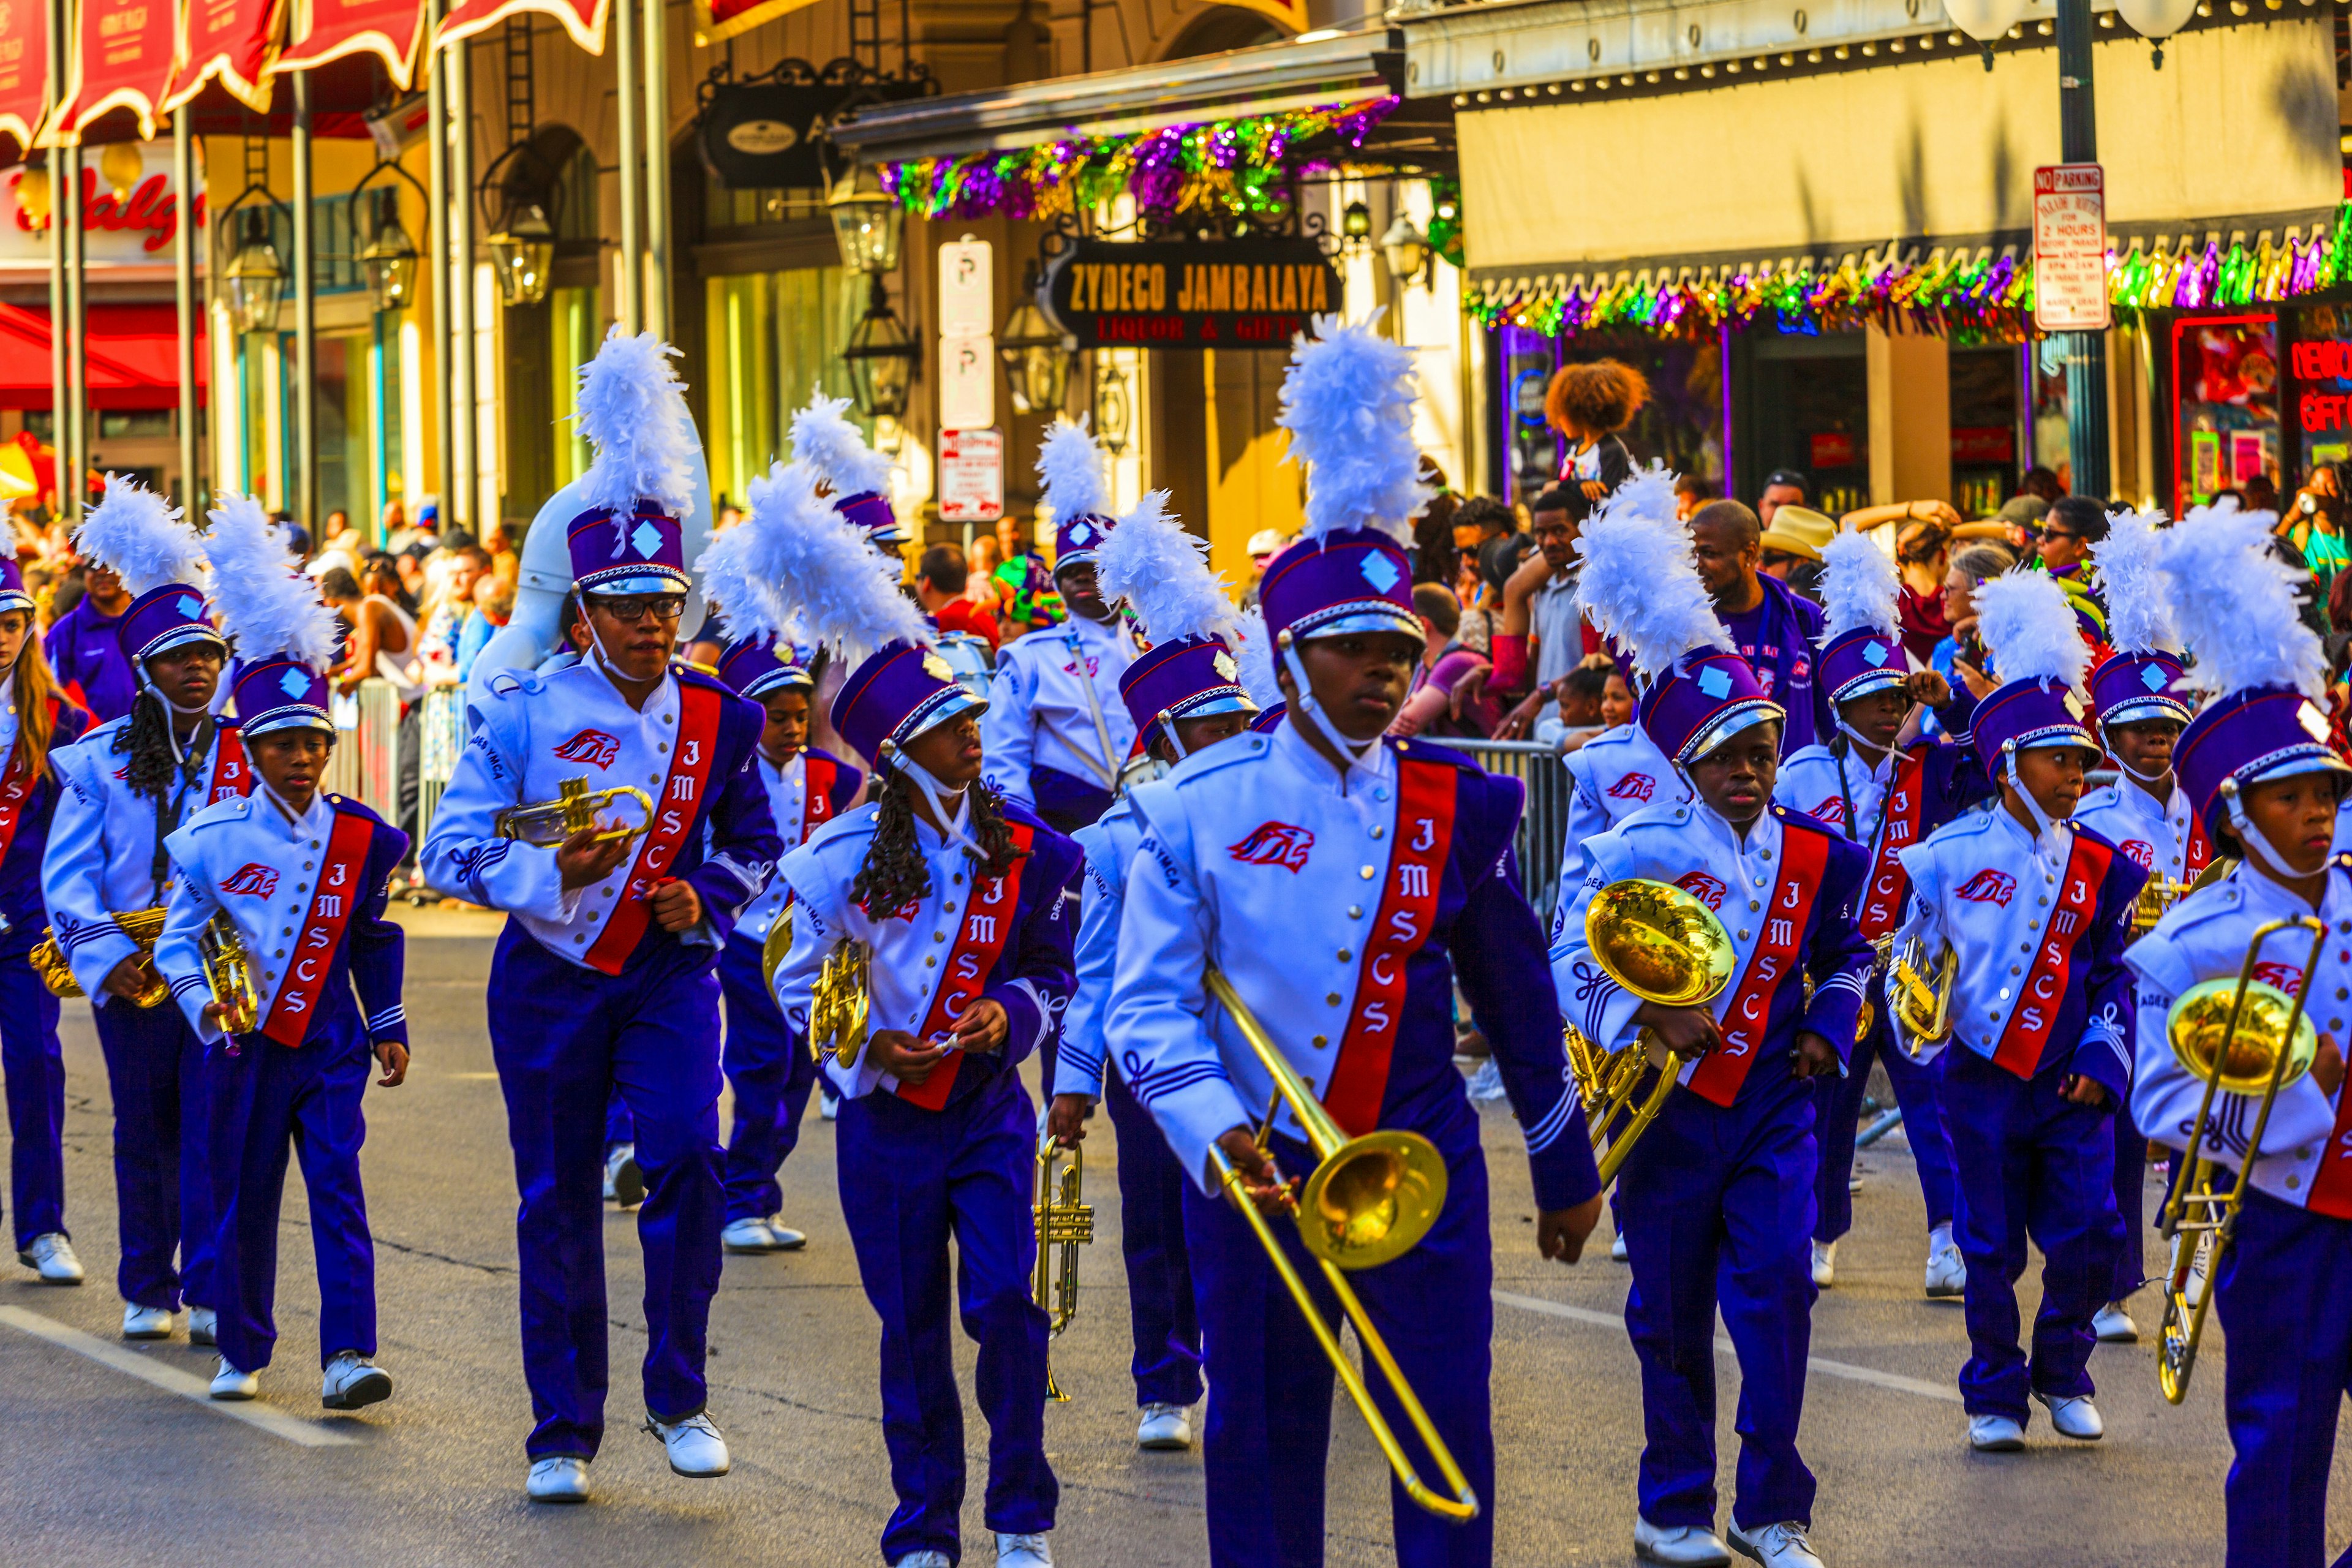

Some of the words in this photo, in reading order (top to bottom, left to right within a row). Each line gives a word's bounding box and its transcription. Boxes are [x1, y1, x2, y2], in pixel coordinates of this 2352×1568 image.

[2036, 172, 2052, 190] NO
[2055, 172, 2099, 188] PARKING
[2043, 225, 2051, 238] 2
[2057, 224, 2097, 236] HOURS
[2062, 213, 2077, 221] FOR
[2062, 251, 2079, 260] AND
[1070, 264, 1166, 311] ZYDECO
[1177, 264, 1327, 311] JAMBALAYA
[1098, 317, 1184, 341] LIQUOR
[1200, 317, 1218, 340] &
[486, 747, 504, 780] YMCA
[1155, 847, 1180, 888] YMCA
[1093, 871, 1108, 900] YMCA
[805, 904, 826, 937] YMCA
[1363, 818, 1436, 1033] JMSCS
[284, 863, 347, 1014] JMSCS
[1724, 881, 1800, 1058] JMSCS
[2021, 880, 2087, 1033] JMSCS
